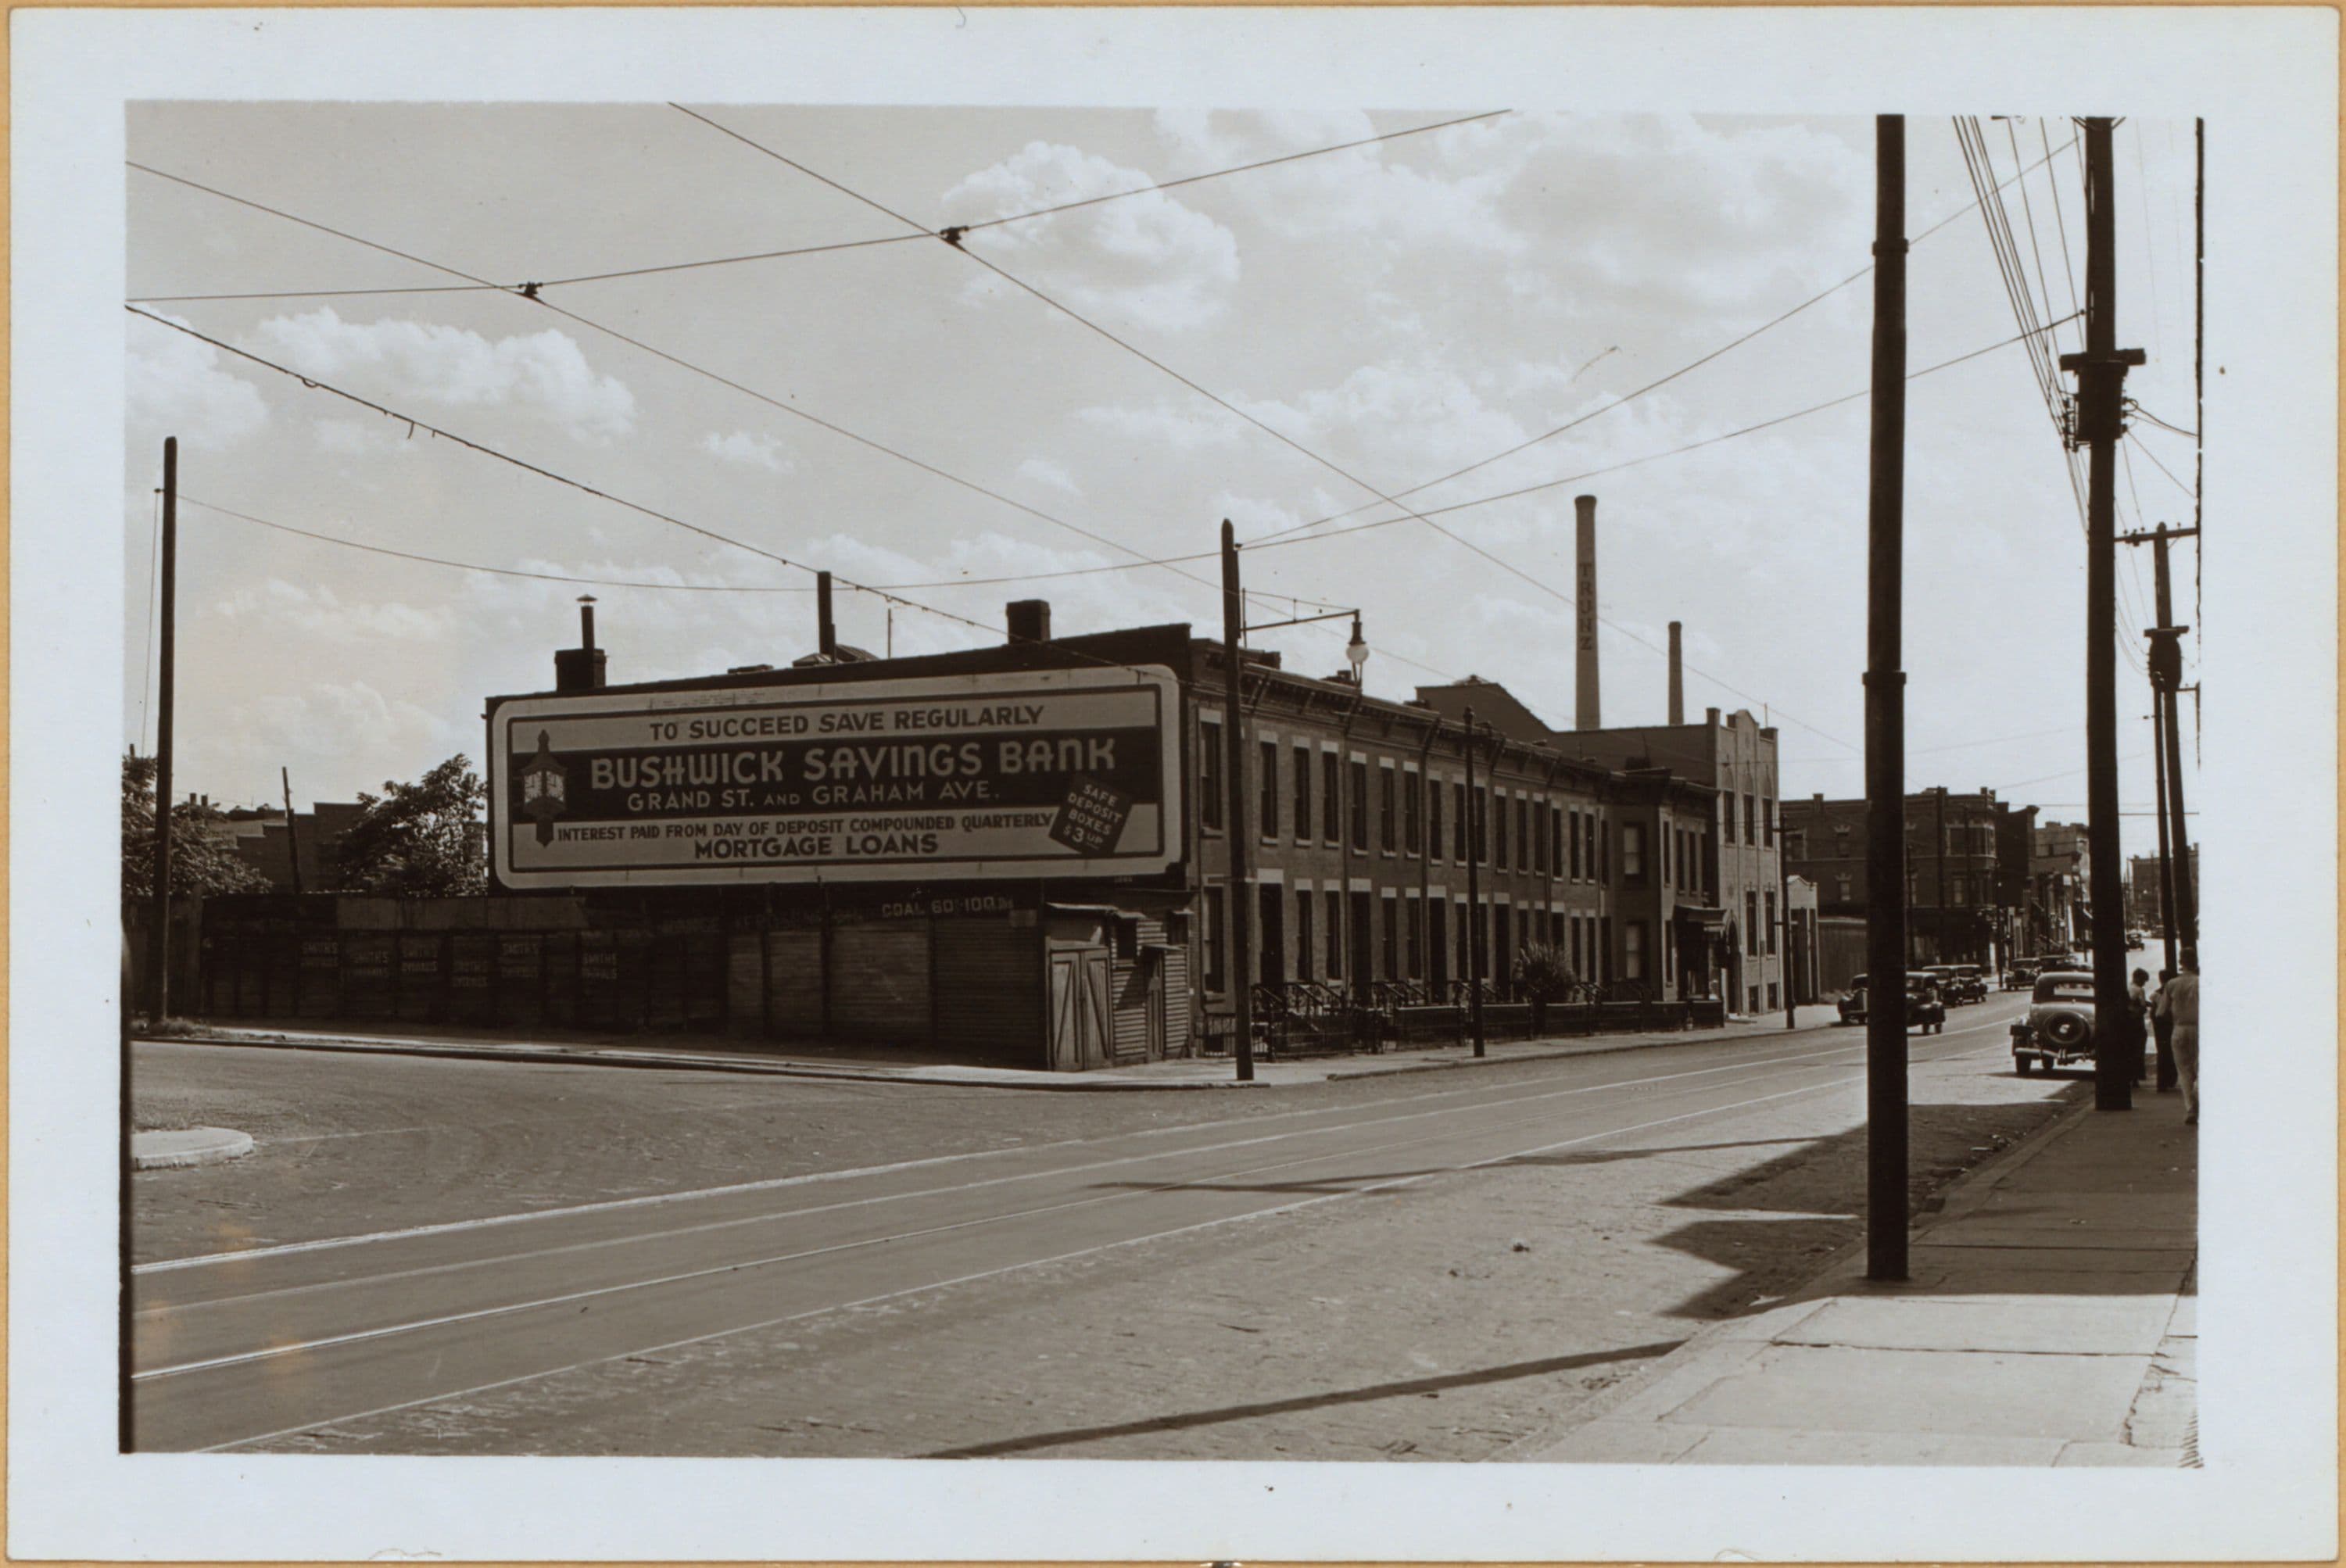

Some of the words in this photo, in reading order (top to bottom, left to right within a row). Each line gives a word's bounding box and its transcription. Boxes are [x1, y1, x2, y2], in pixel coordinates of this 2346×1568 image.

[650, 723, 679, 741] TO
[689, 715, 809, 739] SUCCEED
[818, 711, 884, 733] SAVE
[894, 705, 1045, 730] REGULARLY
[590, 750, 784, 789] BUSHWICK
[803, 742, 983, 781] SAVINGS
[999, 737, 1116, 775] BANK
[628, 791, 711, 812] GRAND
[722, 789, 755, 808] ST.
[764, 792, 801, 806] AND
[812, 784, 924, 805] GRAHAM
[939, 780, 1001, 800] AVE.
[1067, 792, 1123, 823] DEPOSIT
[1083, 784, 1118, 807] SAFE
[557, 825, 626, 843] INTEREST
[630, 824, 661, 840] PAID
[665, 823, 707, 839] FROM
[713, 822, 744, 837] DAY
[749, 821, 770, 836] OF
[775, 818, 845, 836] DEPOSIT
[849, 815, 955, 833] COMPOUNDED
[961, 812, 1055, 832] QUARTERLY
[1068, 808, 1112, 835] BOXES
[694, 836, 833, 859] MORTGAGE
[846, 833, 940, 854] LOANS
[1087, 832, 1104, 844] UP
[882, 902, 926, 918] COAL
